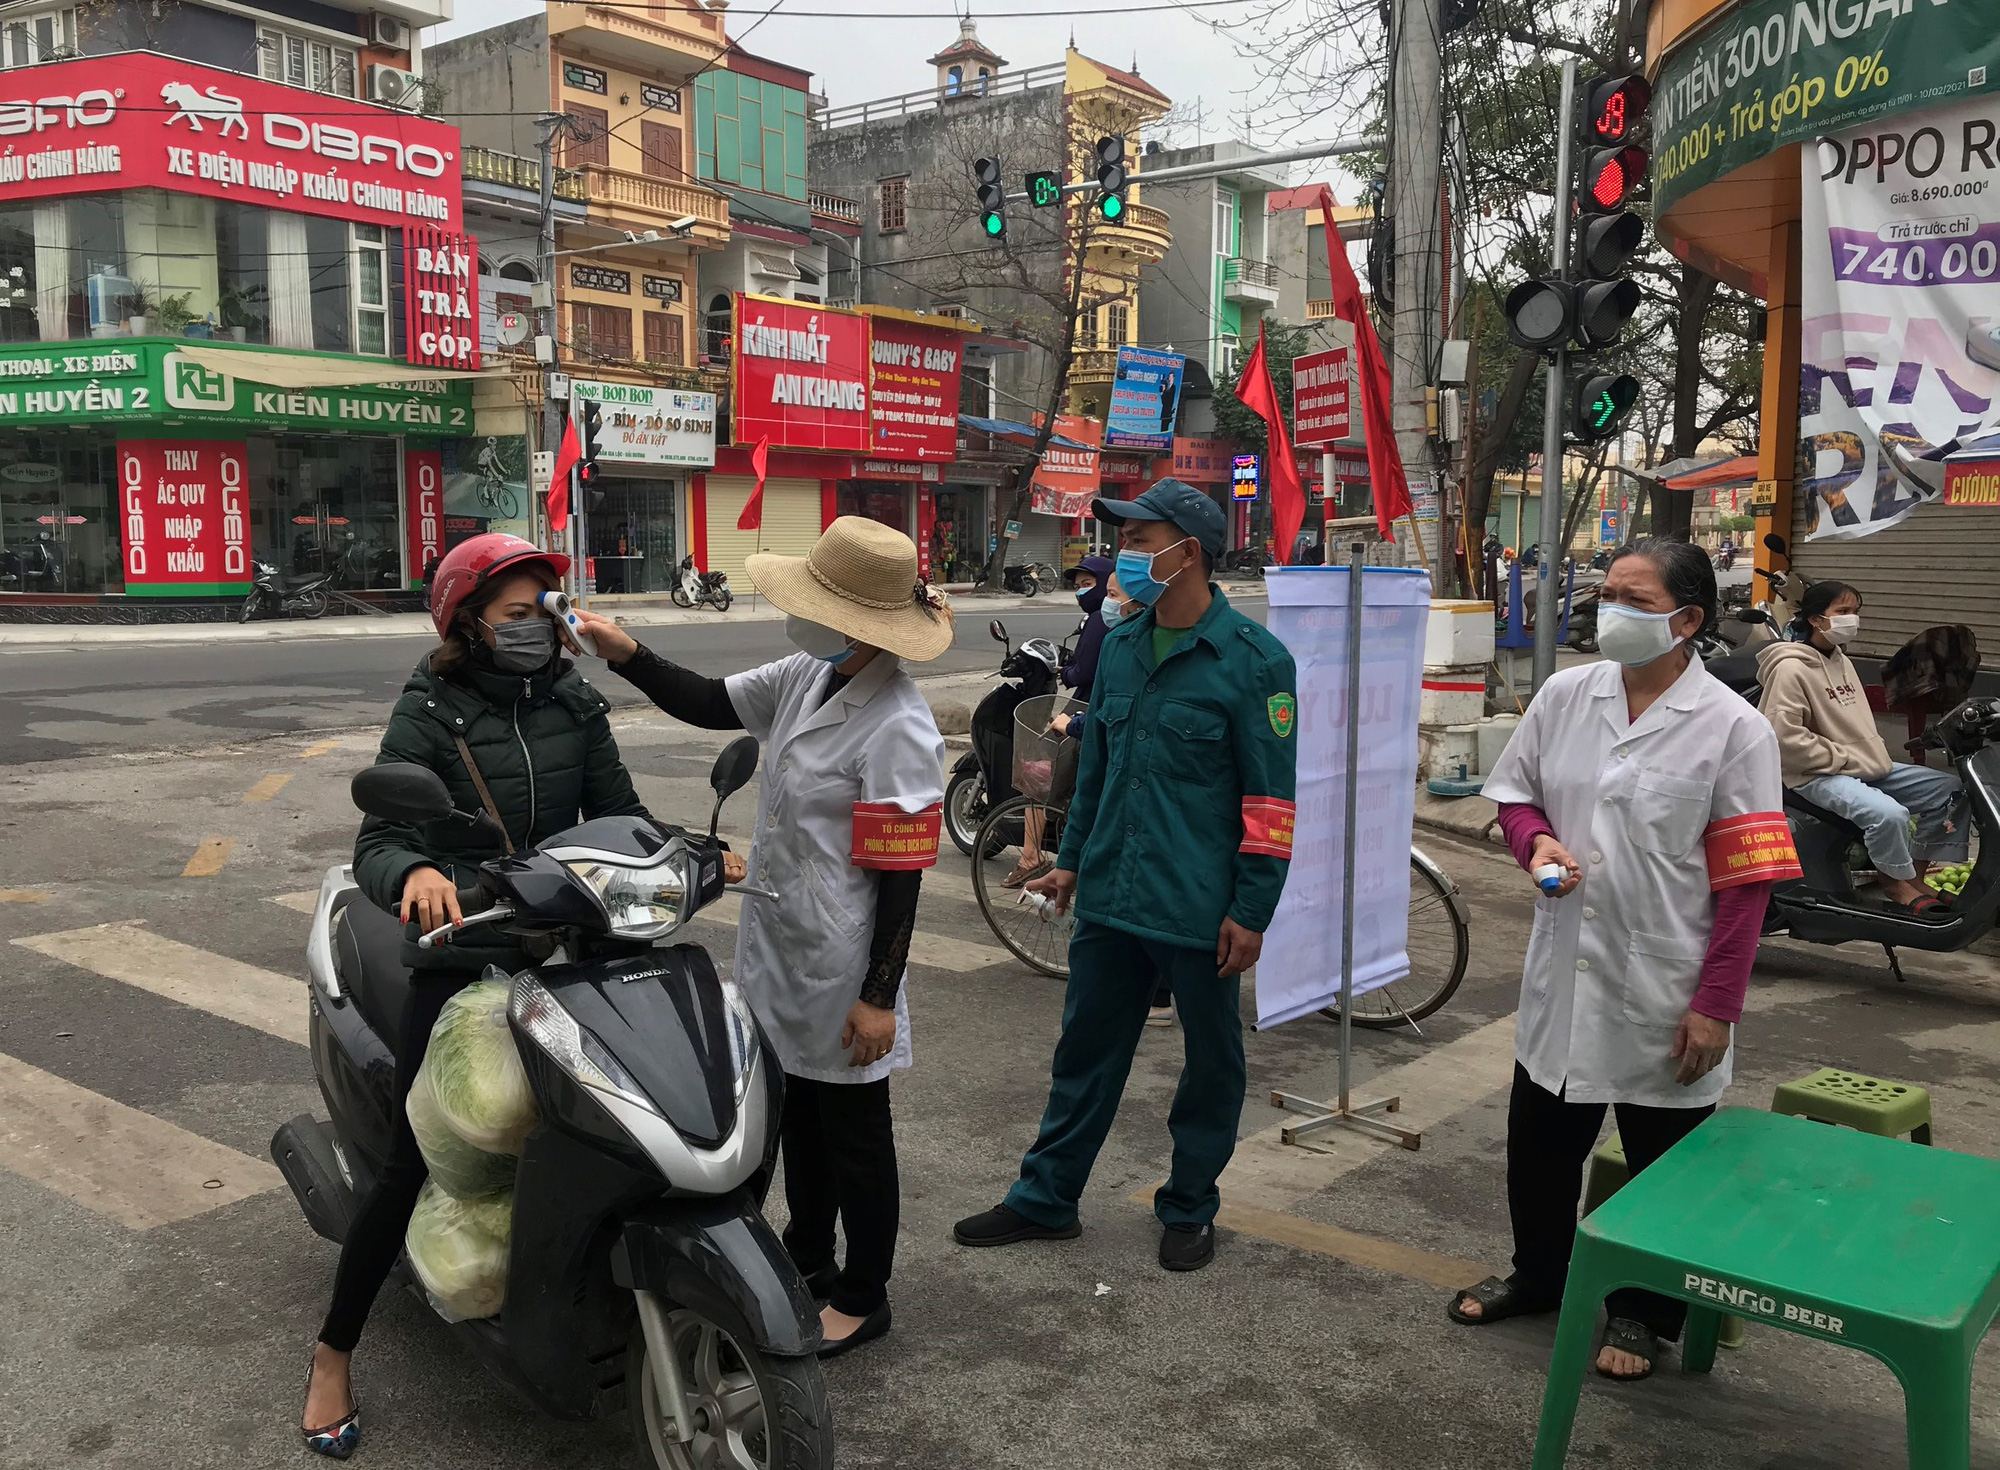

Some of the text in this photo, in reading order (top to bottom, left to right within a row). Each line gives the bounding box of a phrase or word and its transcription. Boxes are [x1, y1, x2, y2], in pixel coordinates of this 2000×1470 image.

[1676, 47, 1720, 120] TIỀN
[1730, 88, 1764, 142] Trả
[1770, 73, 1826, 132] góp
[1834, 50, 1890, 98] 0%
[1830, 113, 1841, 125] giá
[1919, 81, 1967, 99] 10/02/2021
[0, 140, 122, 182] ẨU CHÍNH HÃNG
[263, 113, 445, 178] DIBAO
[1816, 119, 2000, 184] OPPO R
[167, 146, 449, 221] XE ĐIỆN NHẬP KHẨU CHÍNH HÃNG
[1890, 193, 1910, 204] Giá:
[1890, 217, 1970, 238] Trả trước chỉ
[416, 245, 470, 279] BÁN
[418, 287, 472, 319] TRẢ
[419, 326, 472, 359] GÓP
[742, 315, 831, 364] KÍNH MẮT
[0, 349, 137, 379] THOẠI XE ĐIỆN
[923, 346, 957, 373] BABY
[25, 379, 125, 413] HUYỀN
[131, 387, 150, 409] 2
[254, 391, 466, 426] KIÊN HUYỀN 2
[602, 384, 627, 401] BON
[629, 387, 654, 404] BON
[771, 374, 866, 411] AN KHANG
[622, 429, 636, 443] ĐỒ
[666, 416, 682, 433] SƠ
[684, 420, 712, 434] SINH
[164, 449, 198, 471] THAY
[157, 477, 206, 507] ẮC QUY
[1950, 469, 2000, 504] CƯỜNG
[125, 457, 146, 574] DIBAO
[165, 514, 202, 542] NHẬP
[221, 457, 244, 574] DIBAO
[167, 544, 204, 573] KHẨU
[882, 821, 928, 833] TỔ CÔNG TÁC
[1740, 831, 1752, 845] TỔ
[1754, 831, 1775, 843] CÔNG
[864, 835, 883, 850] PHÒNG
[885, 835, 906, 852] CHỐNG
[907, 838, 919, 854] DỊCH
[1727, 850, 1749, 869] PHÒNG
[1749, 844, 1773, 864] CHỐNG
[622, 969, 671, 983] HONDA
[1684, 1273, 1845, 1335] PENGO BEER
